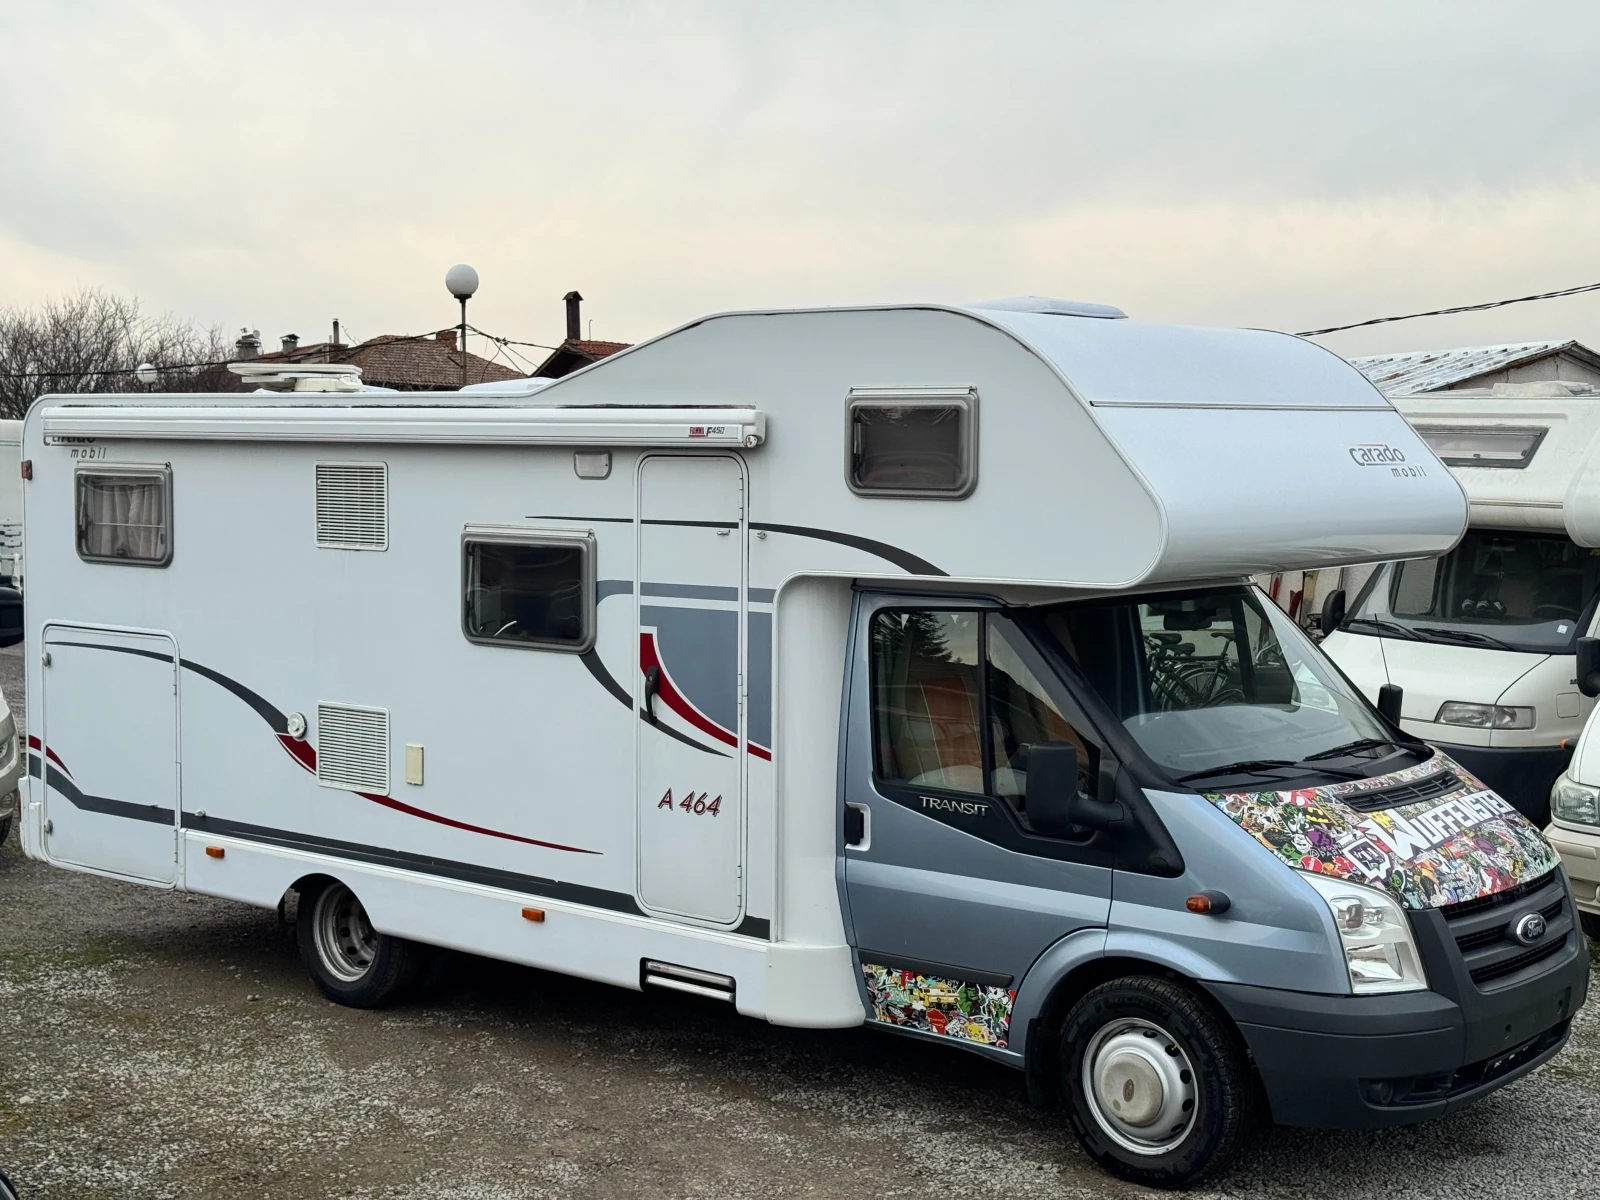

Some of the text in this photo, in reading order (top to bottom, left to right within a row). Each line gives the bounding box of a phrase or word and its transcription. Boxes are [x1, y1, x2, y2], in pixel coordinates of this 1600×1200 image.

[70, 447, 107, 459] mobil
[1390, 465, 1427, 478] mobil
[657, 787, 723, 818] A 464
[919, 796, 989, 817] TRANSIT
[1527, 919, 1544, 938] Ford
